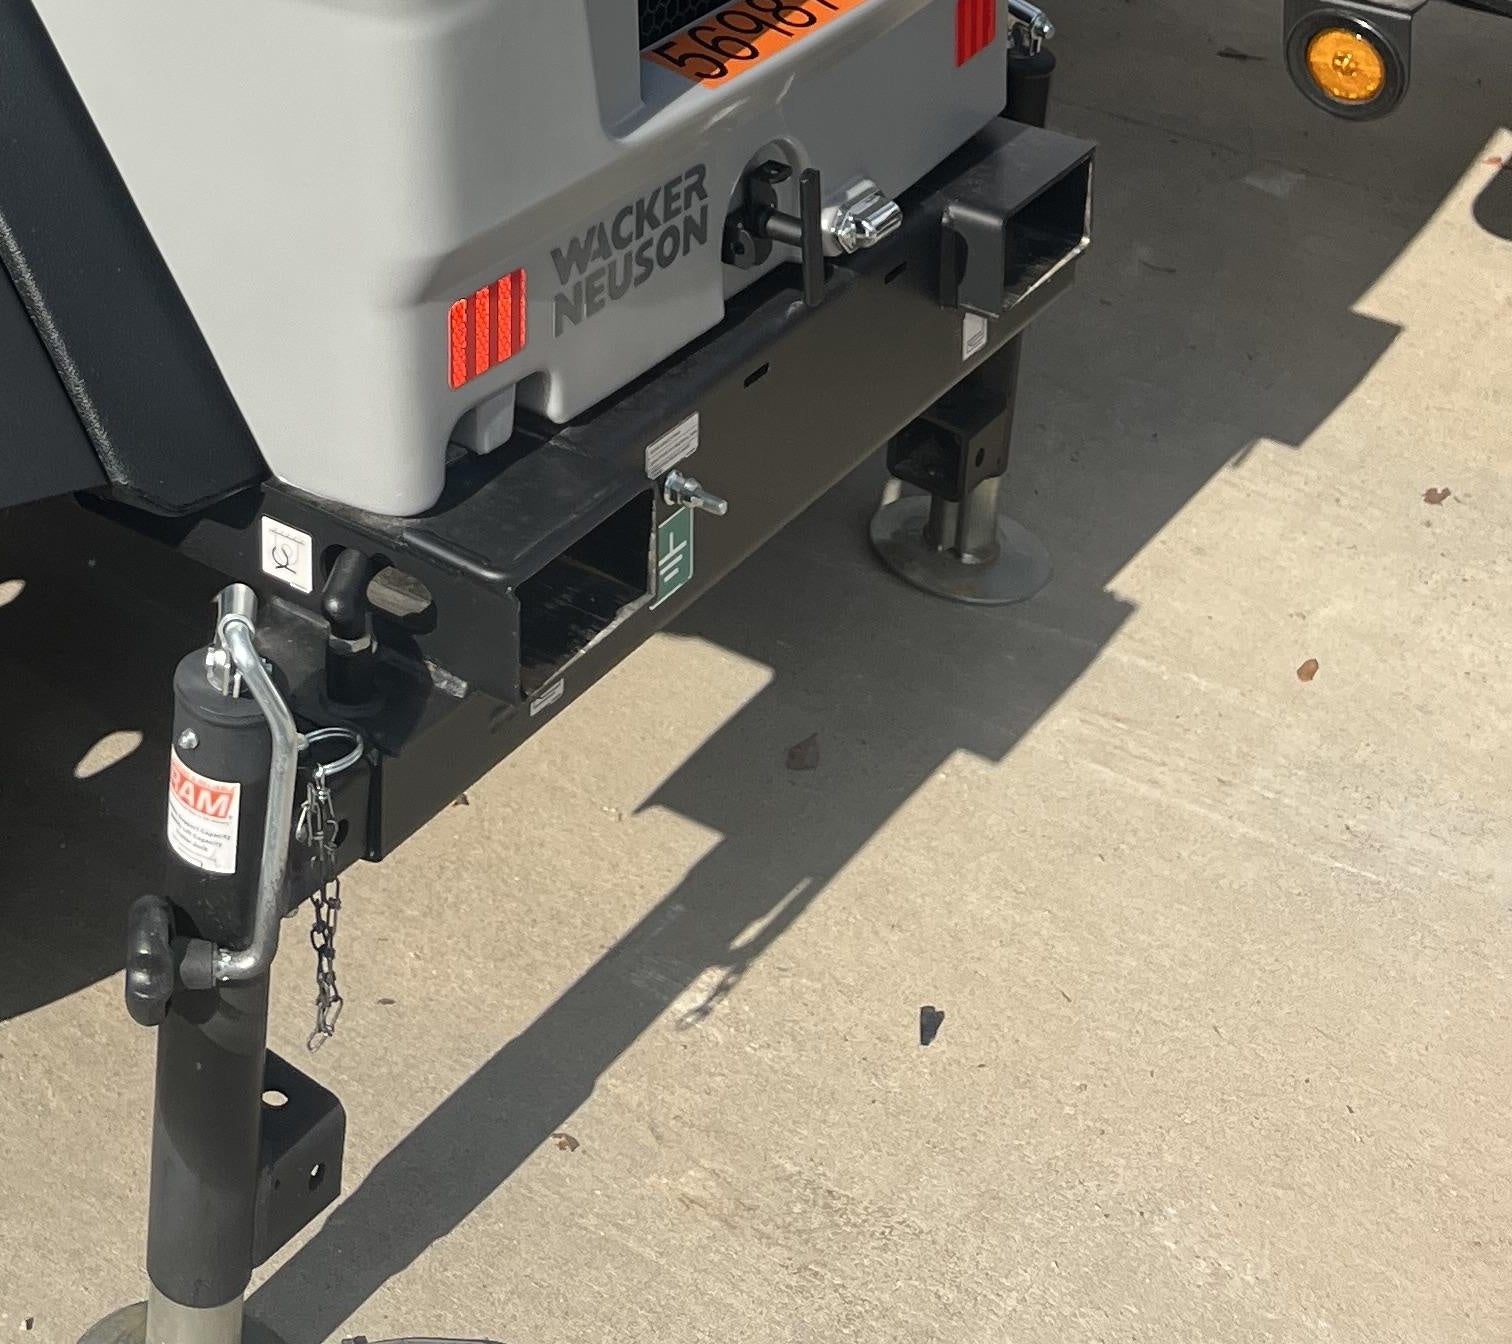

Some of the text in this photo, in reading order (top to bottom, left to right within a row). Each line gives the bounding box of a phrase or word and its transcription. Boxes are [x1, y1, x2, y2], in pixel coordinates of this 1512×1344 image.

[550, 162, 710, 286] WACKER
[553, 204, 710, 339] NEUSON
[171, 765, 231, 819] RAM
